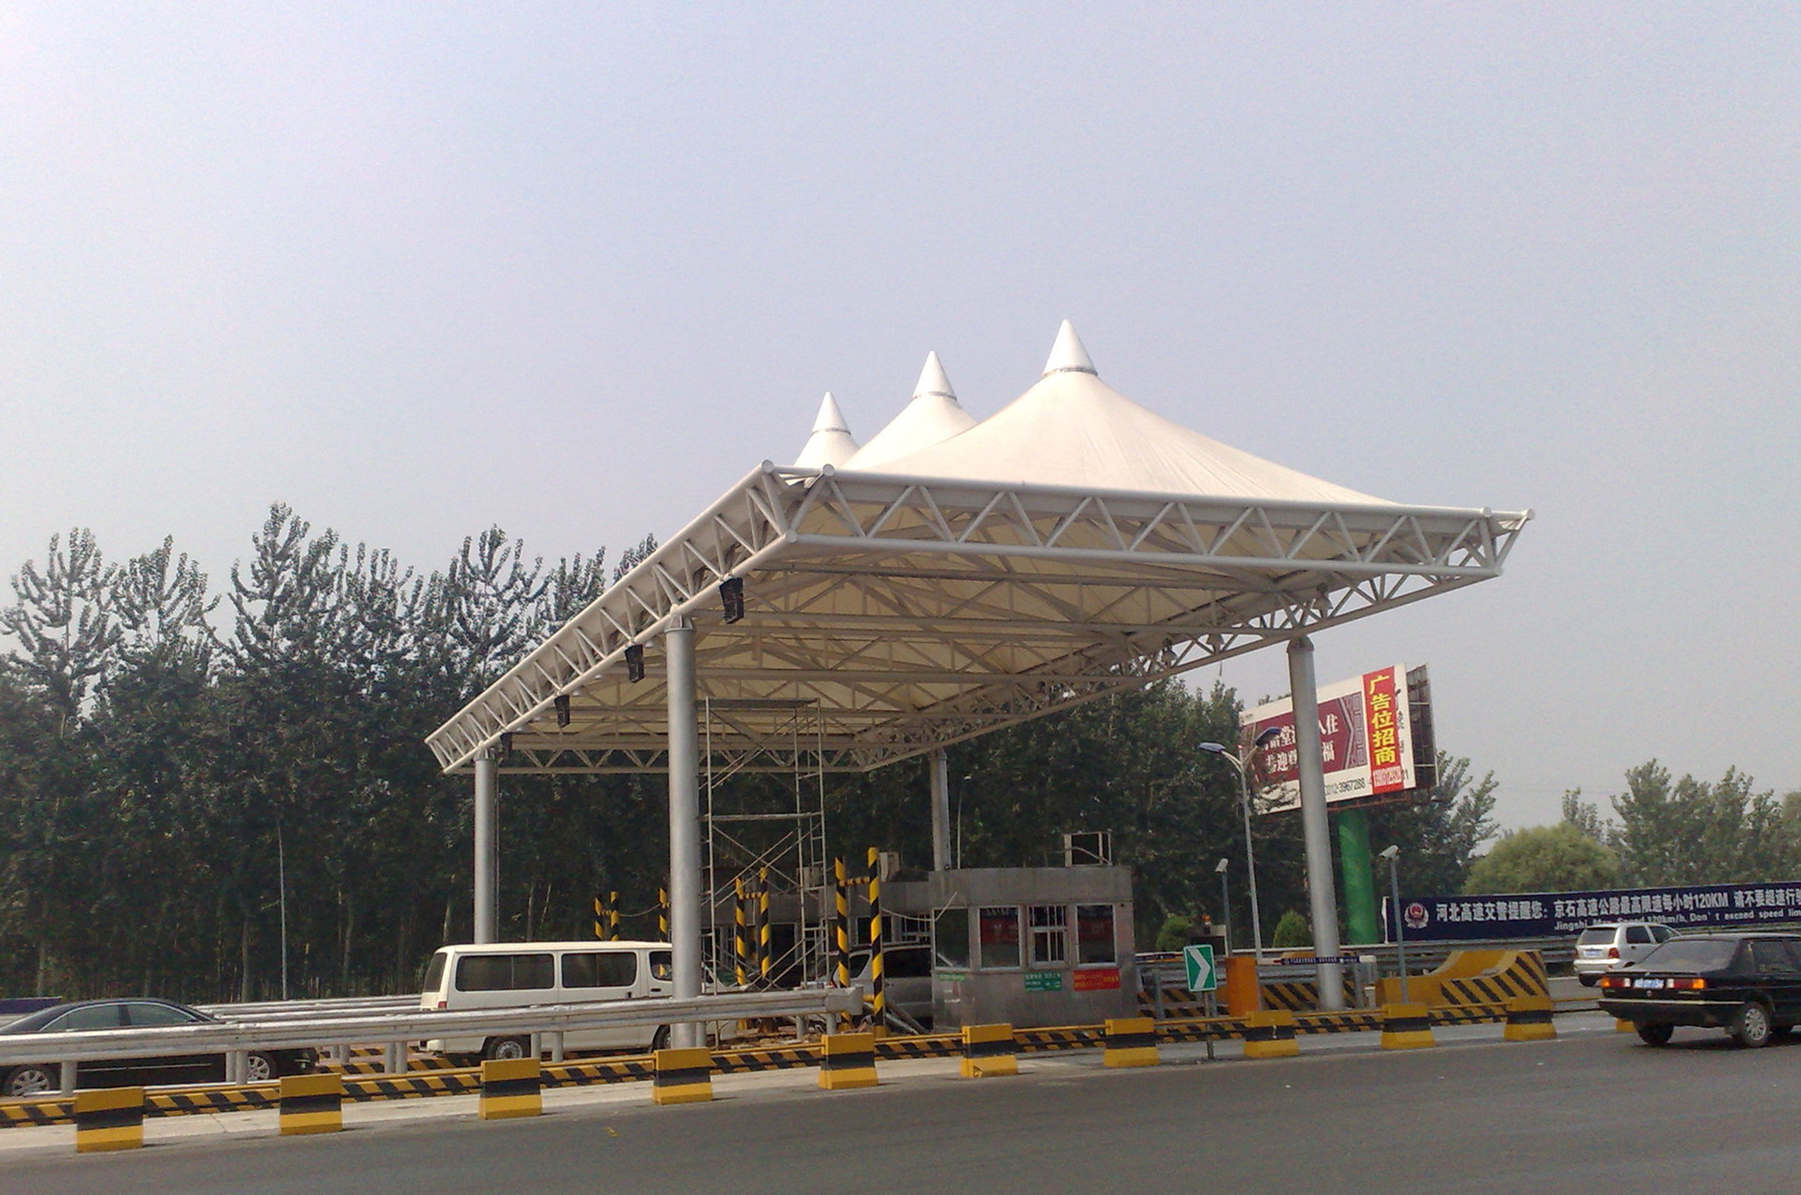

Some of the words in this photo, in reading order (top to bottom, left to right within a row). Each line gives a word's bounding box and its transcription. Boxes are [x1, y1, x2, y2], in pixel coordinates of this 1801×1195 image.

[1369, 675, 1396, 766] 广告位招商
[1759, 908, 1784, 919] speed
